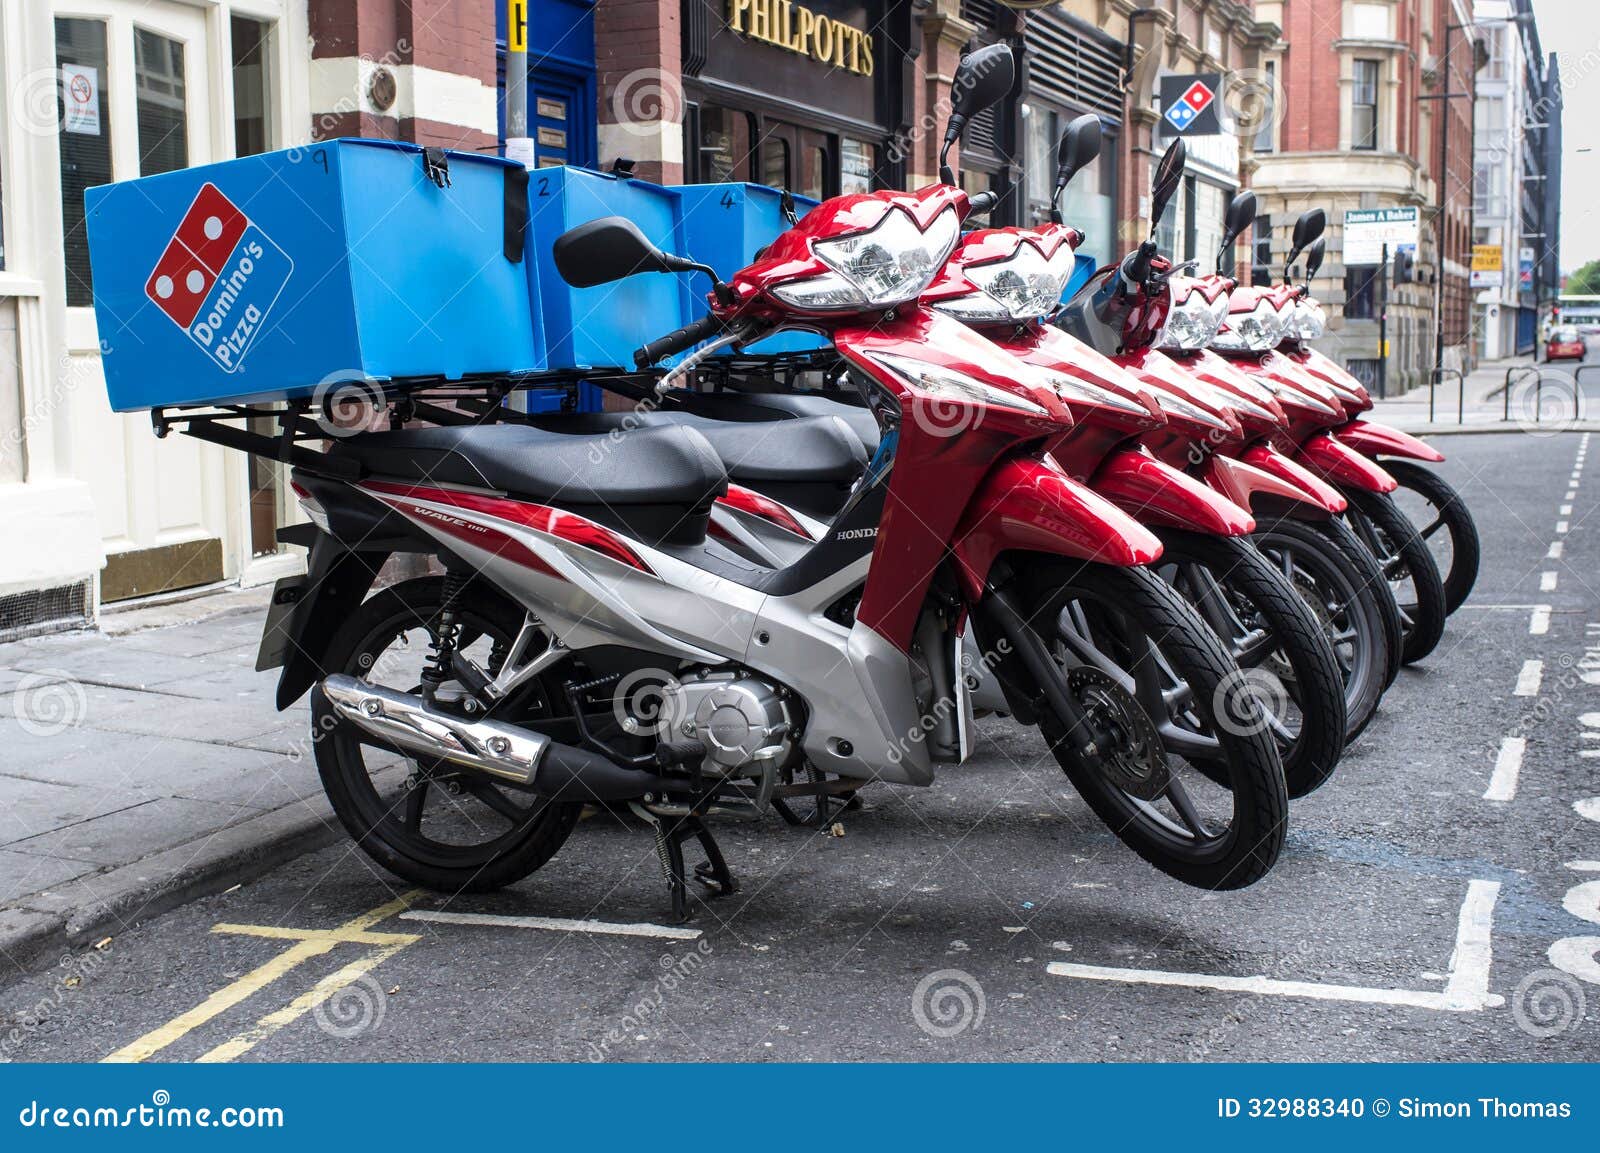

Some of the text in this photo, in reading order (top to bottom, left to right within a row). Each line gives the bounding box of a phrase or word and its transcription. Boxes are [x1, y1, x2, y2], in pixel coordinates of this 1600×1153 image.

[730, 0, 874, 77] PHILPOTTS
[312, 148, 329, 175] 9
[538, 177, 550, 196] 2
[720, 190, 736, 209] 4
[1377, 211, 1385, 221] A
[193, 241, 263, 347] Domino's
[215, 303, 262, 368] Pizza
[414, 506, 467, 527] WAVE
